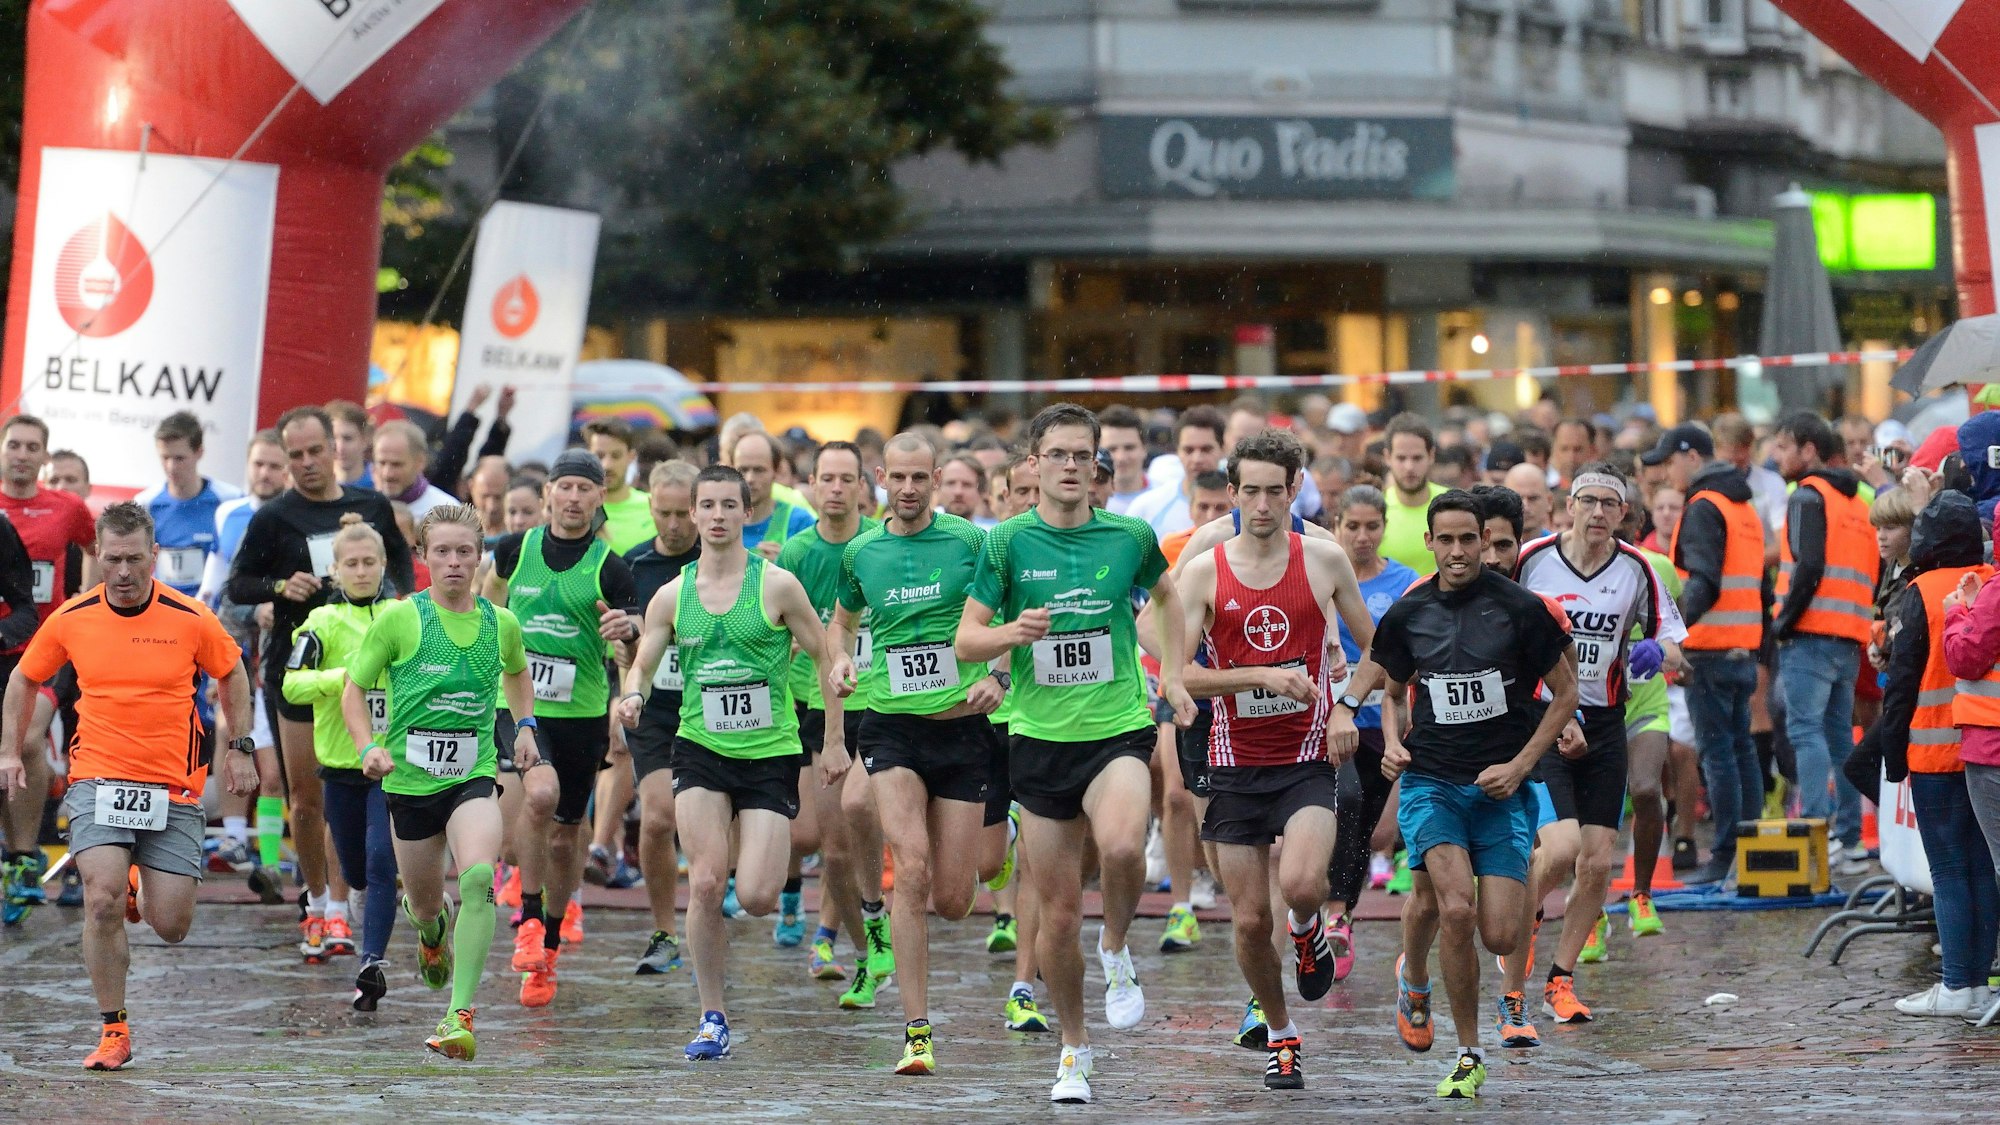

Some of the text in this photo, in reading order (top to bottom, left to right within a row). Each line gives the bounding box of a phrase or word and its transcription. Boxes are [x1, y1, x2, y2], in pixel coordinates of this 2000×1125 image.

[1150, 120, 1409, 196] Quo Vadis
[46, 357, 223, 402] BELKAW
[1032, 569, 1057, 577] bunert
[901, 582, 940, 599] bunert
[1044, 600, 1081, 608] Rhein-Berg
[1248, 623, 1286, 634] BAYER
[1261, 609, 1273, 648] BAYER
[1053, 642, 1092, 668] 169
[531, 661, 554, 685] 171
[901, 652, 940, 677] 532
[902, 679, 946, 692] BELKAW
[1048, 671, 1099, 683] BELKAW
[1446, 681, 1485, 706] 578
[720, 693, 752, 716] 173
[1249, 701, 1298, 715] BELKAW
[1445, 706, 1493, 721] BELKAW
[716, 718, 760, 731] BELKAW
[427, 740, 458, 762] 172
[426, 767, 464, 777] ELKAW
[113, 788, 152, 813] 323
[107, 814, 154, 829] BELKAW
